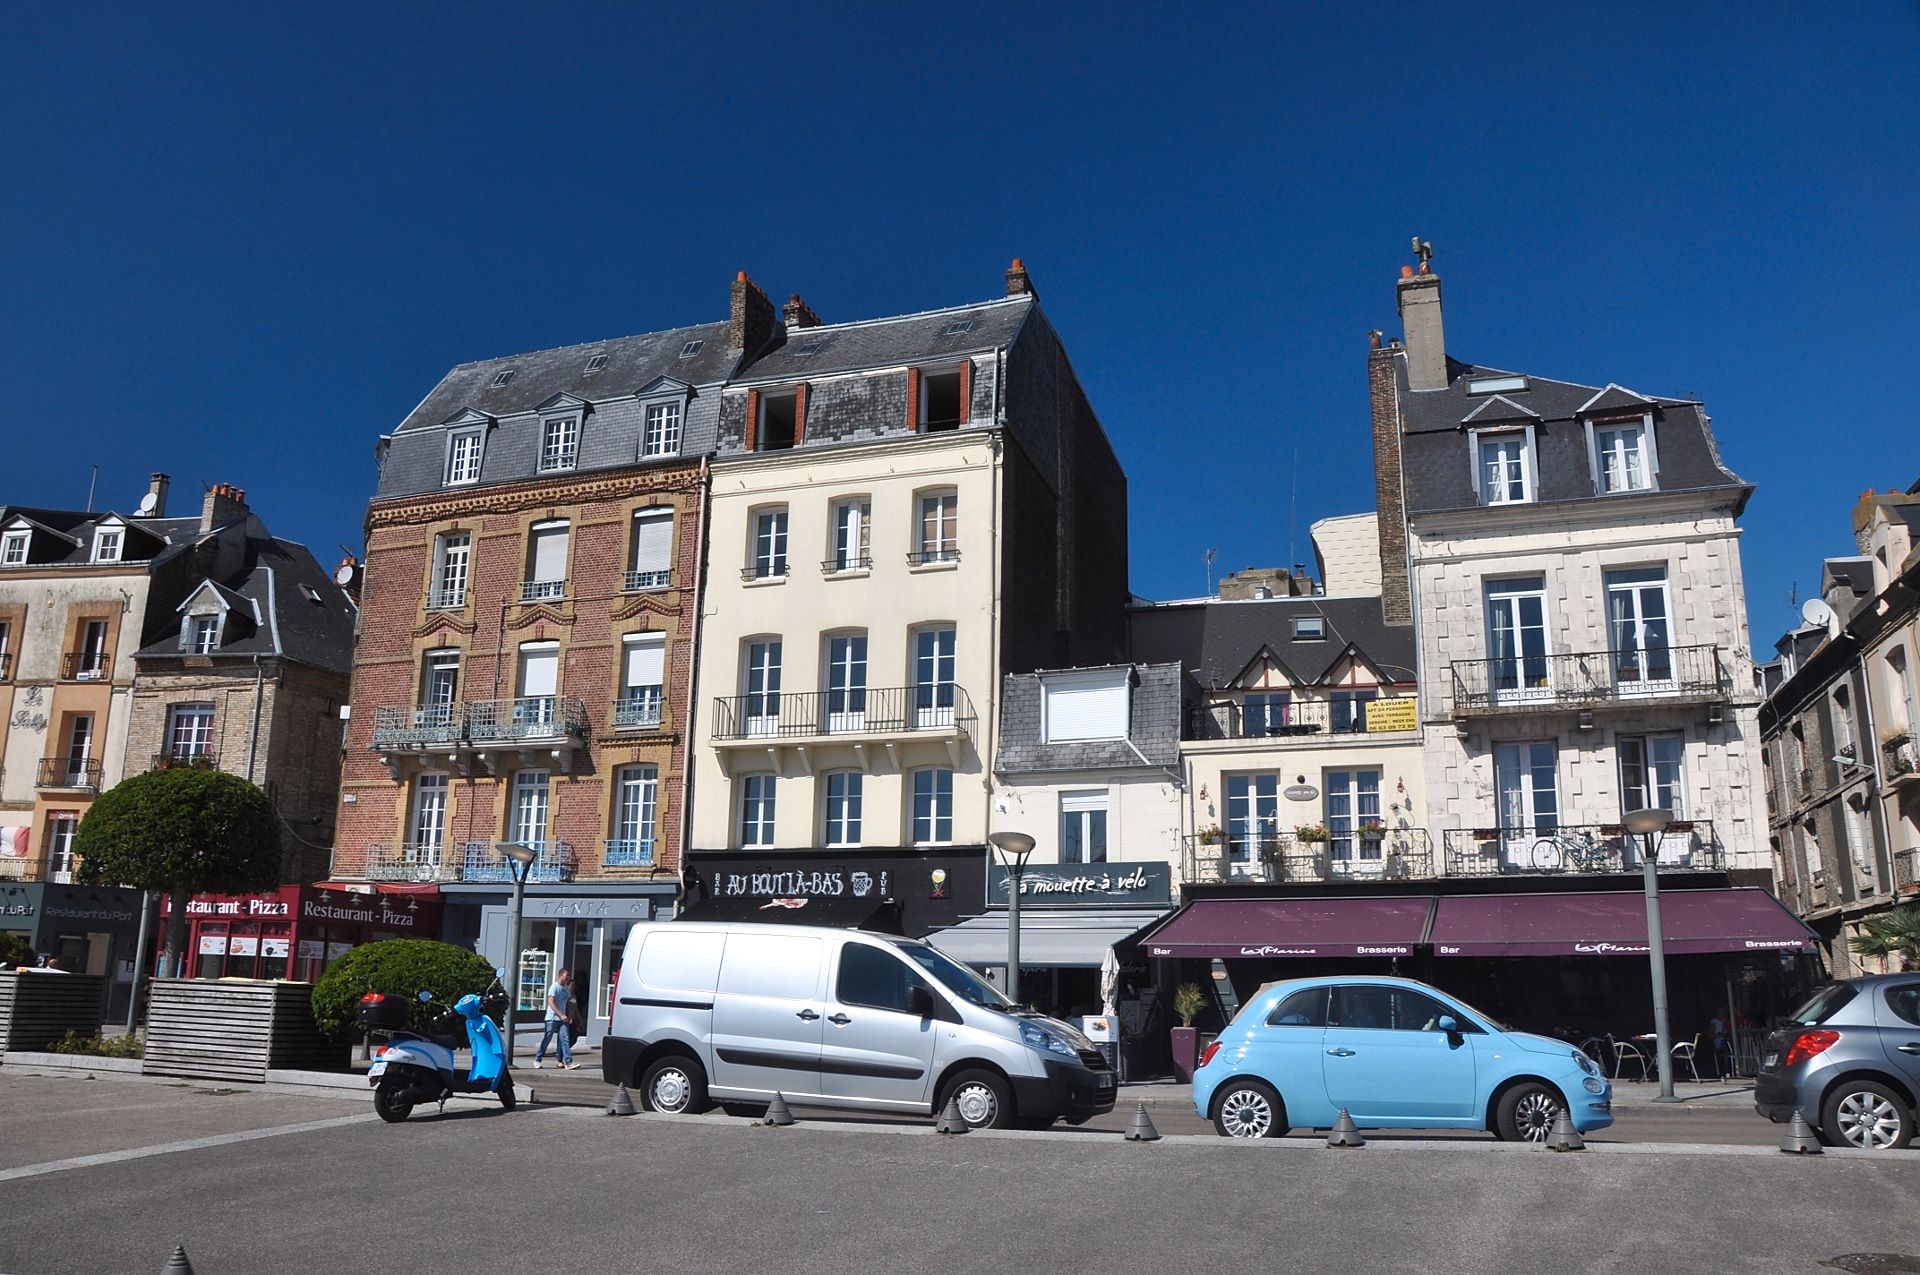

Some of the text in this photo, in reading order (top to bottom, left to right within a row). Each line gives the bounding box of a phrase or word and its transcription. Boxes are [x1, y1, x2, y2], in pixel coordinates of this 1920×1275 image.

[724, 874, 749, 896] AU
[751, 872, 786, 895] BOUT
[1033, 876, 1095, 894] mouette
[1101, 872, 1111, 890] à
[1118, 866, 1147, 889] vélo
[165, 896, 241, 914] staurant
[249, 899, 289, 915] Pizza
[304, 900, 374, 922] Restaurant
[382, 909, 414, 926] Pizza
[1357, 946, 1407, 954] Brasserie
[1440, 946, 1460, 954] Bar
[1745, 940, 1803, 948] Brasserie
[1153, 947, 1172, 955] Bar
